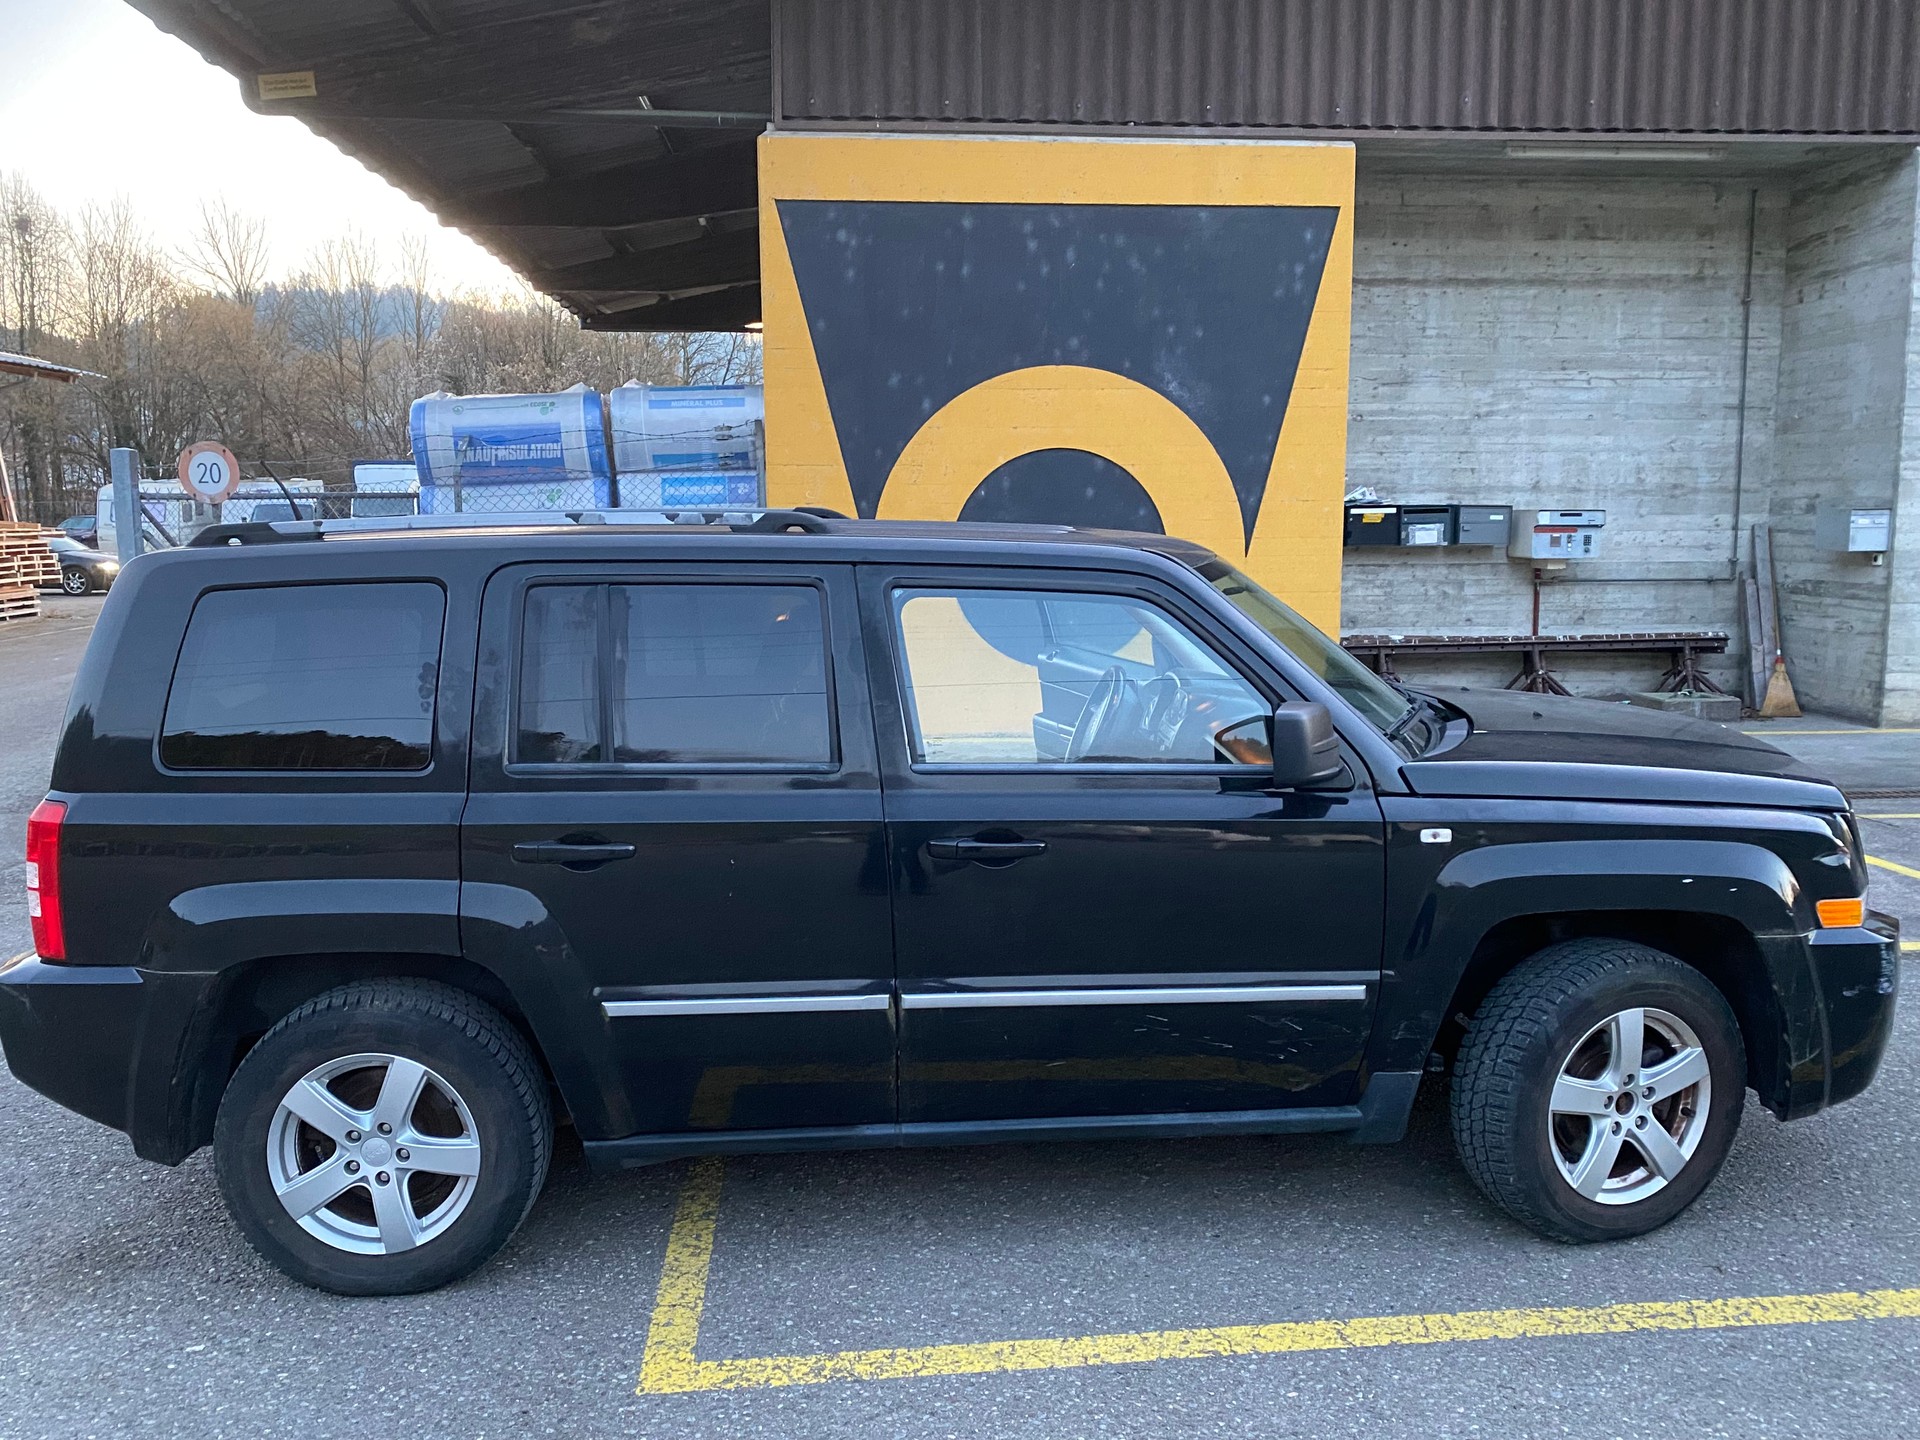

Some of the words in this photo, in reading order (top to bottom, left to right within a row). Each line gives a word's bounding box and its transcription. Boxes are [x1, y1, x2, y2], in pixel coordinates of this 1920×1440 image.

[671, 400, 704, 408] MINERAL
[705, 399, 724, 407] PLUS
[197, 462, 222, 484] 20
